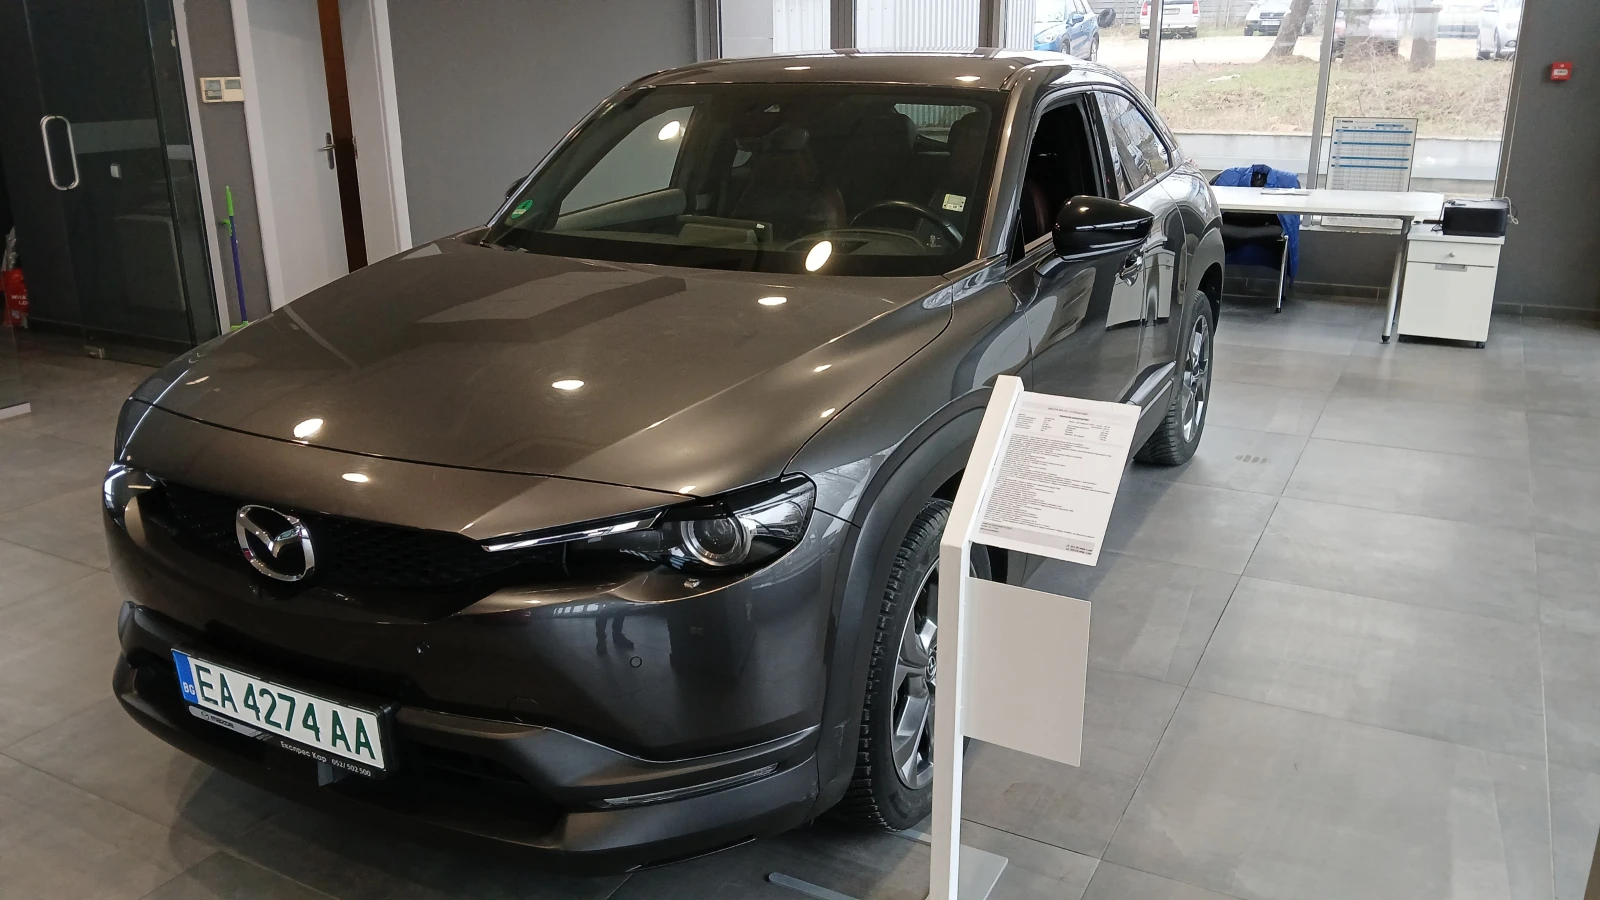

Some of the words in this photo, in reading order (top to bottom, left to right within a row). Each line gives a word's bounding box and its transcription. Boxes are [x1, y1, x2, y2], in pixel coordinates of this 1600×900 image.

[182, 681, 196, 697] BG
[194, 664, 239, 713] EA
[243, 682, 322, 743] 4274
[331, 709, 377, 761] AA
[346, 763, 359, 773] 502
[358, 767, 371, 777] 500
